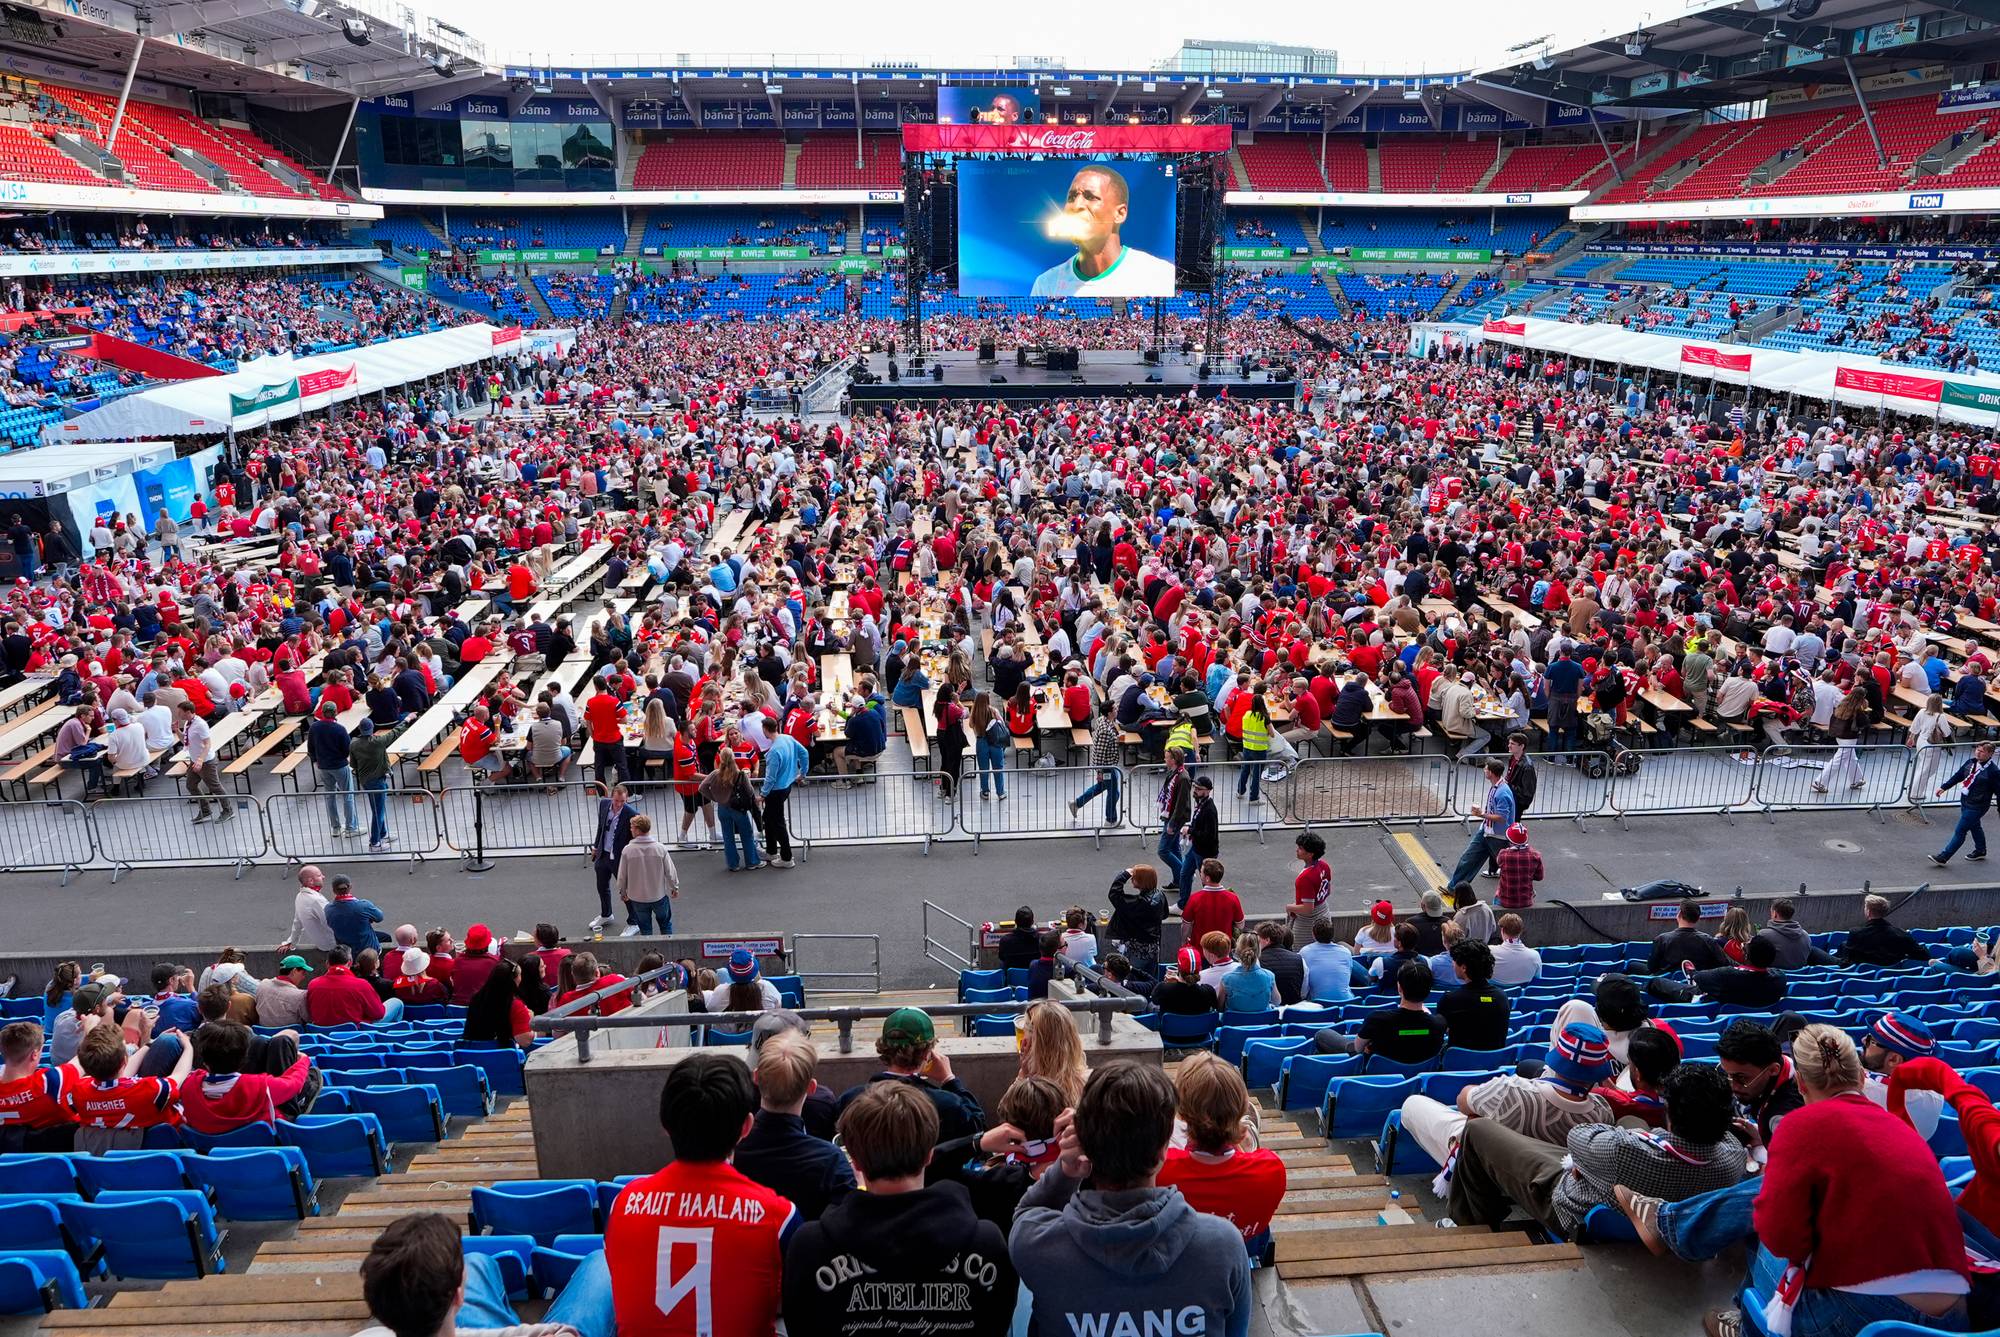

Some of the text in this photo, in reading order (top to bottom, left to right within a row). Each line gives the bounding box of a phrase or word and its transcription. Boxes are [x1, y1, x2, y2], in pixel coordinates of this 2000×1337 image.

[1957, 91, 1991, 101] Norsk Tipping
[385, 95, 408, 108] bama
[468, 101, 498, 114] bama
[568, 104, 599, 116] bama
[1558, 106, 1583, 118] bama
[865, 109, 894, 120] bama
[1400, 113, 1428, 124] bama
[1467, 112, 1497, 123] bama
[1040, 131, 1096, 149] Coca-Cola
[1507, 195, 1532, 203] THON
[1912, 196, 1940, 208] THON
[492, 252, 508, 260] KIWI
[523, 252, 539, 260] KIWI
[554, 252, 571, 260] KIWI
[678, 250, 694, 258] KIWI
[710, 250, 726, 258] KIWI
[741, 250, 758, 258] KIWI
[1232, 250, 1248, 258] KIWI
[1261, 250, 1277, 258] KIWI
[1362, 250, 1378, 259] KIWI
[1394, 251, 1410, 259] KIWI
[1426, 252, 1442, 260] KIWI
[1456, 252, 1472, 260] KIWI
[840, 260, 858, 268] KIWI
[1312, 261, 1328, 269] KIWI
[35, 486, 42, 495] 3
[149, 494, 163, 503] THON
[1932, 547, 1940, 559] 8
[521, 638, 530, 651] 9
[786, 715, 796, 734] 9
[460, 726, 470, 744] 9
[624, 1192, 766, 1223] BRAUT HAALAND
[655, 1225, 714, 1337] 9
[846, 1282, 972, 1312] ATELIER
[1064, 1305, 1205, 1337] WANG
[842, 1316, 883, 1337] originals
[898, 1316, 932, 1336] quality
[929, 1320, 975, 1336] garments
